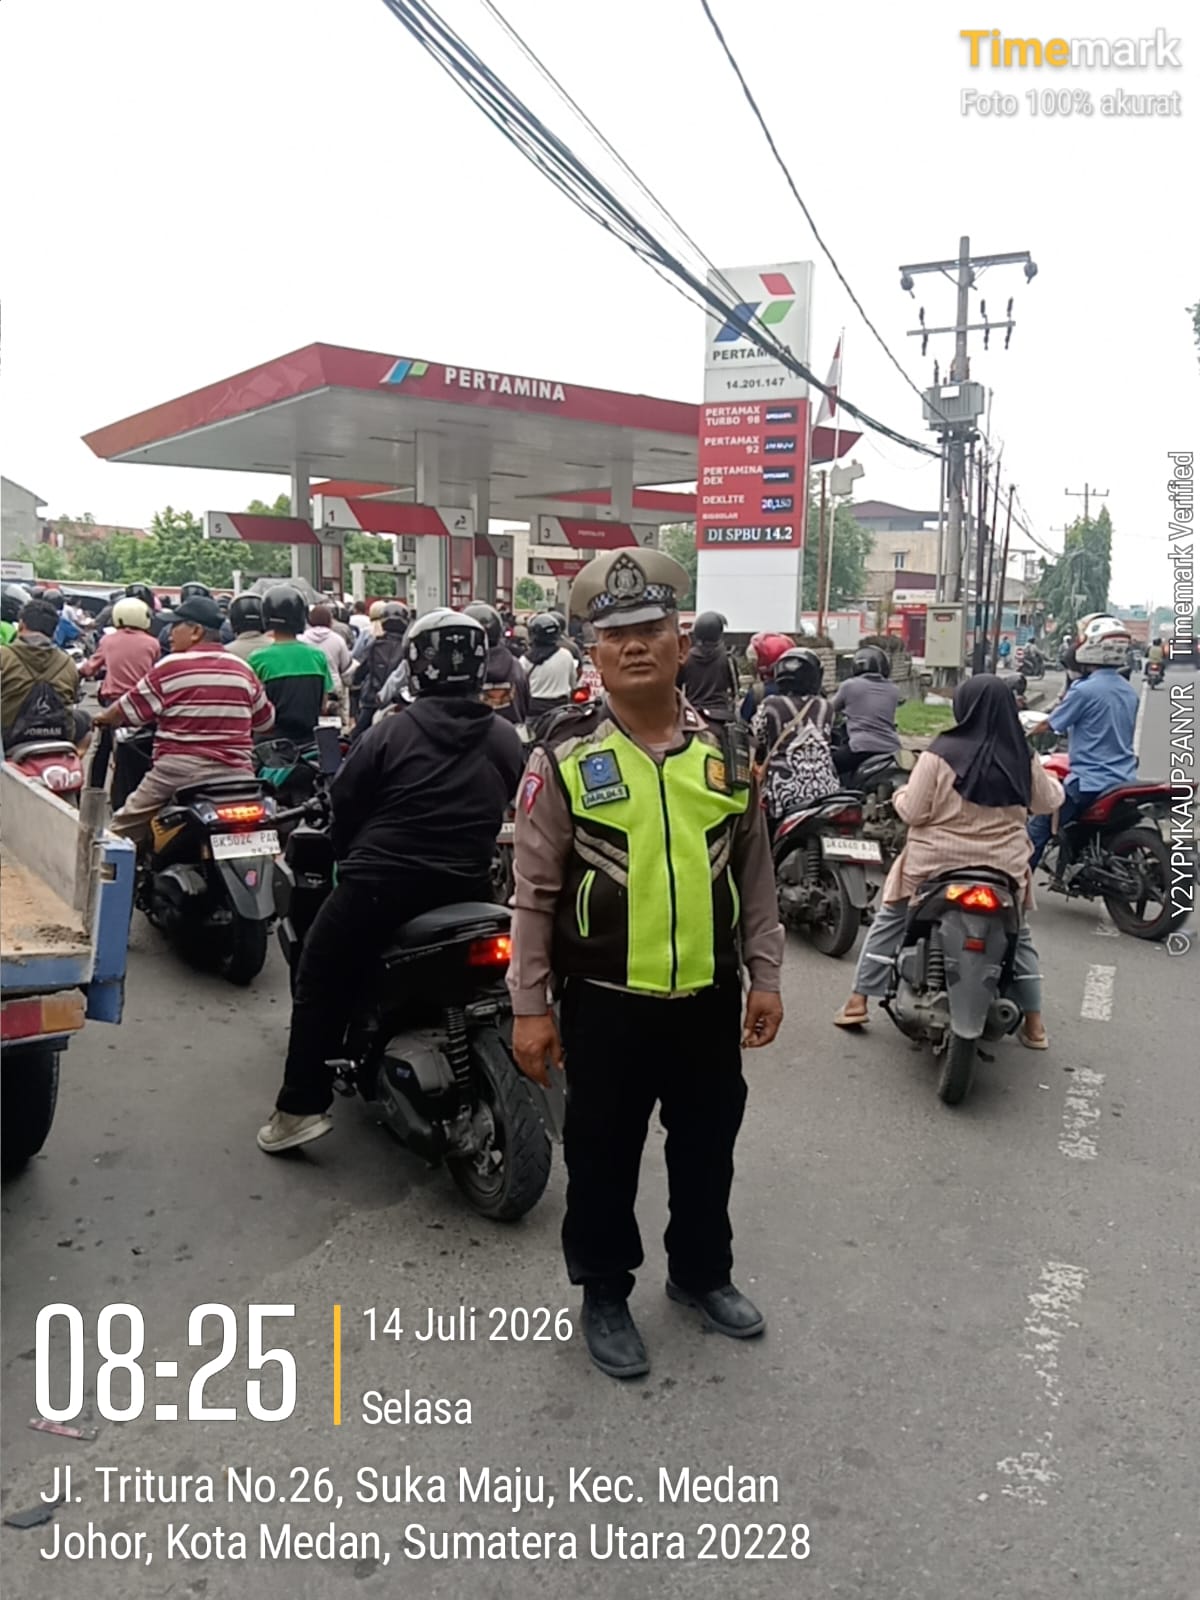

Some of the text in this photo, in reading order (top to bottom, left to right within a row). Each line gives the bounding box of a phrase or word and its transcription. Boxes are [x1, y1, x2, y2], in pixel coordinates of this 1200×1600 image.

[444, 367, 566, 402] PERTAMINA
[726, 377, 785, 390] 14.201.147
[705, 406, 760, 417] PERTAMAX
[706, 416, 741, 427] TURBO
[704, 435, 760, 446] PERTAMAX
[745, 445, 760, 455] 92
[703, 465, 763, 476] PERTAMINA
[703, 476, 724, 486] DEX
[702, 495, 745, 505] DEXLITE
[328, 510, 336, 522] 1
[214, 523, 222, 534] 5
[543, 526, 551, 539] 3
[707, 526, 793, 541] DI SPBU 14.2
[24, 727, 62, 736] JORDAN
